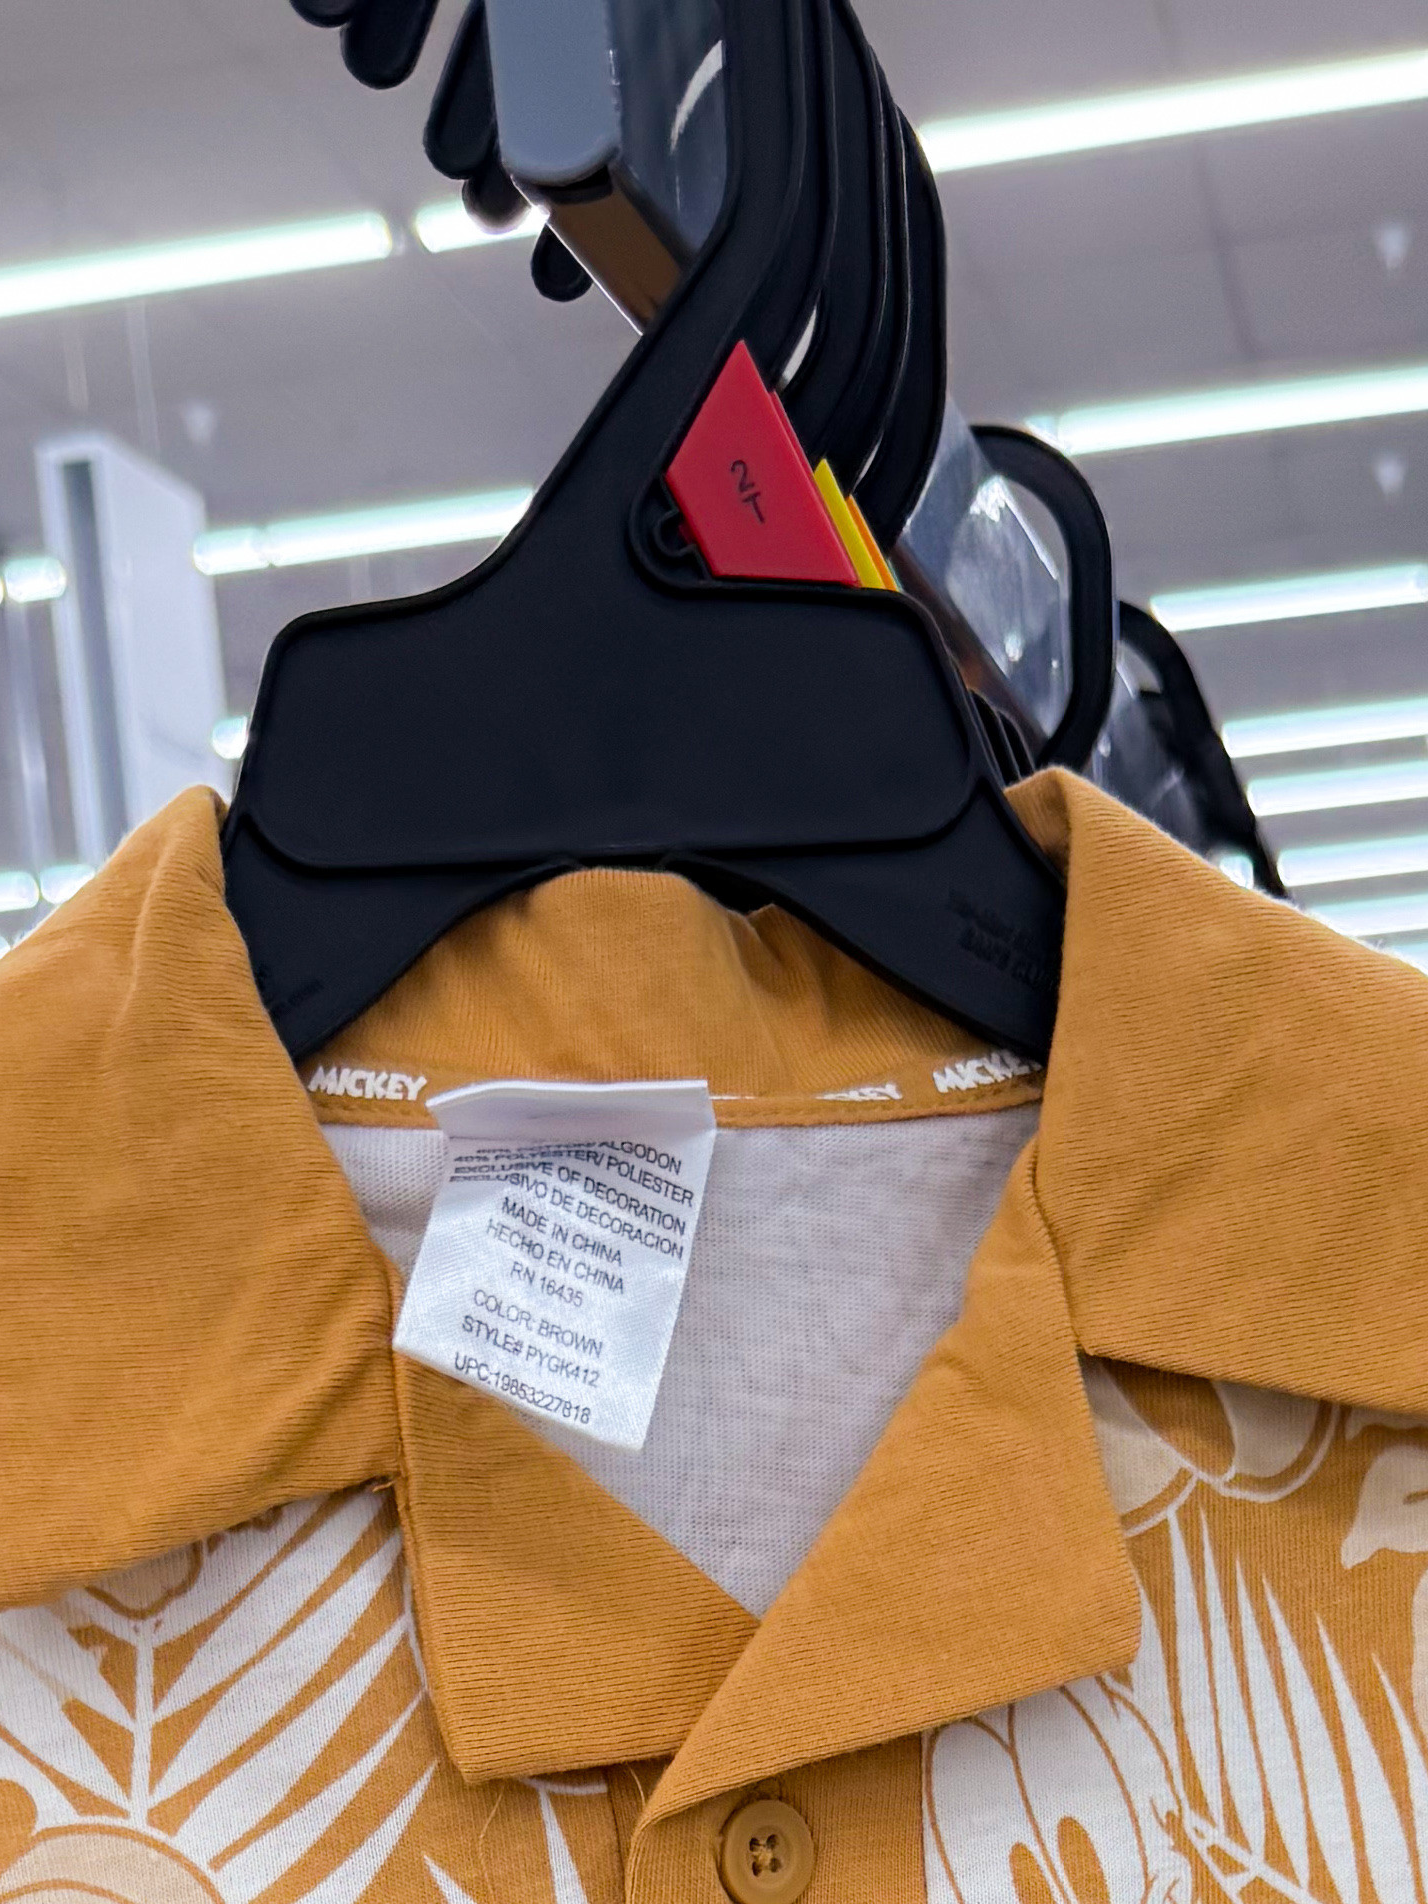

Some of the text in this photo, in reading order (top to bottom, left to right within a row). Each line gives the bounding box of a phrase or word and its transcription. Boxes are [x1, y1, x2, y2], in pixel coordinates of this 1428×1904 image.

[308, 1065, 428, 1101] MICKEY
[454, 1161, 686, 1237] EXCLUSIVE OF DECORATION
[606, 1155, 694, 1208] POLIESTER
[486, 1218, 624, 1295] HECHO EN CHINA
[501, 1196, 622, 1267] MADE IN CHINA
[550, 1188, 575, 1214] DE
[576, 1201, 684, 1261] DECORACION
[510, 1260, 584, 1307] RN 16435
[462, 1315, 600, 1388] STYLE# PYGK412
[474, 1289, 604, 1359] COLOR: BROWN
